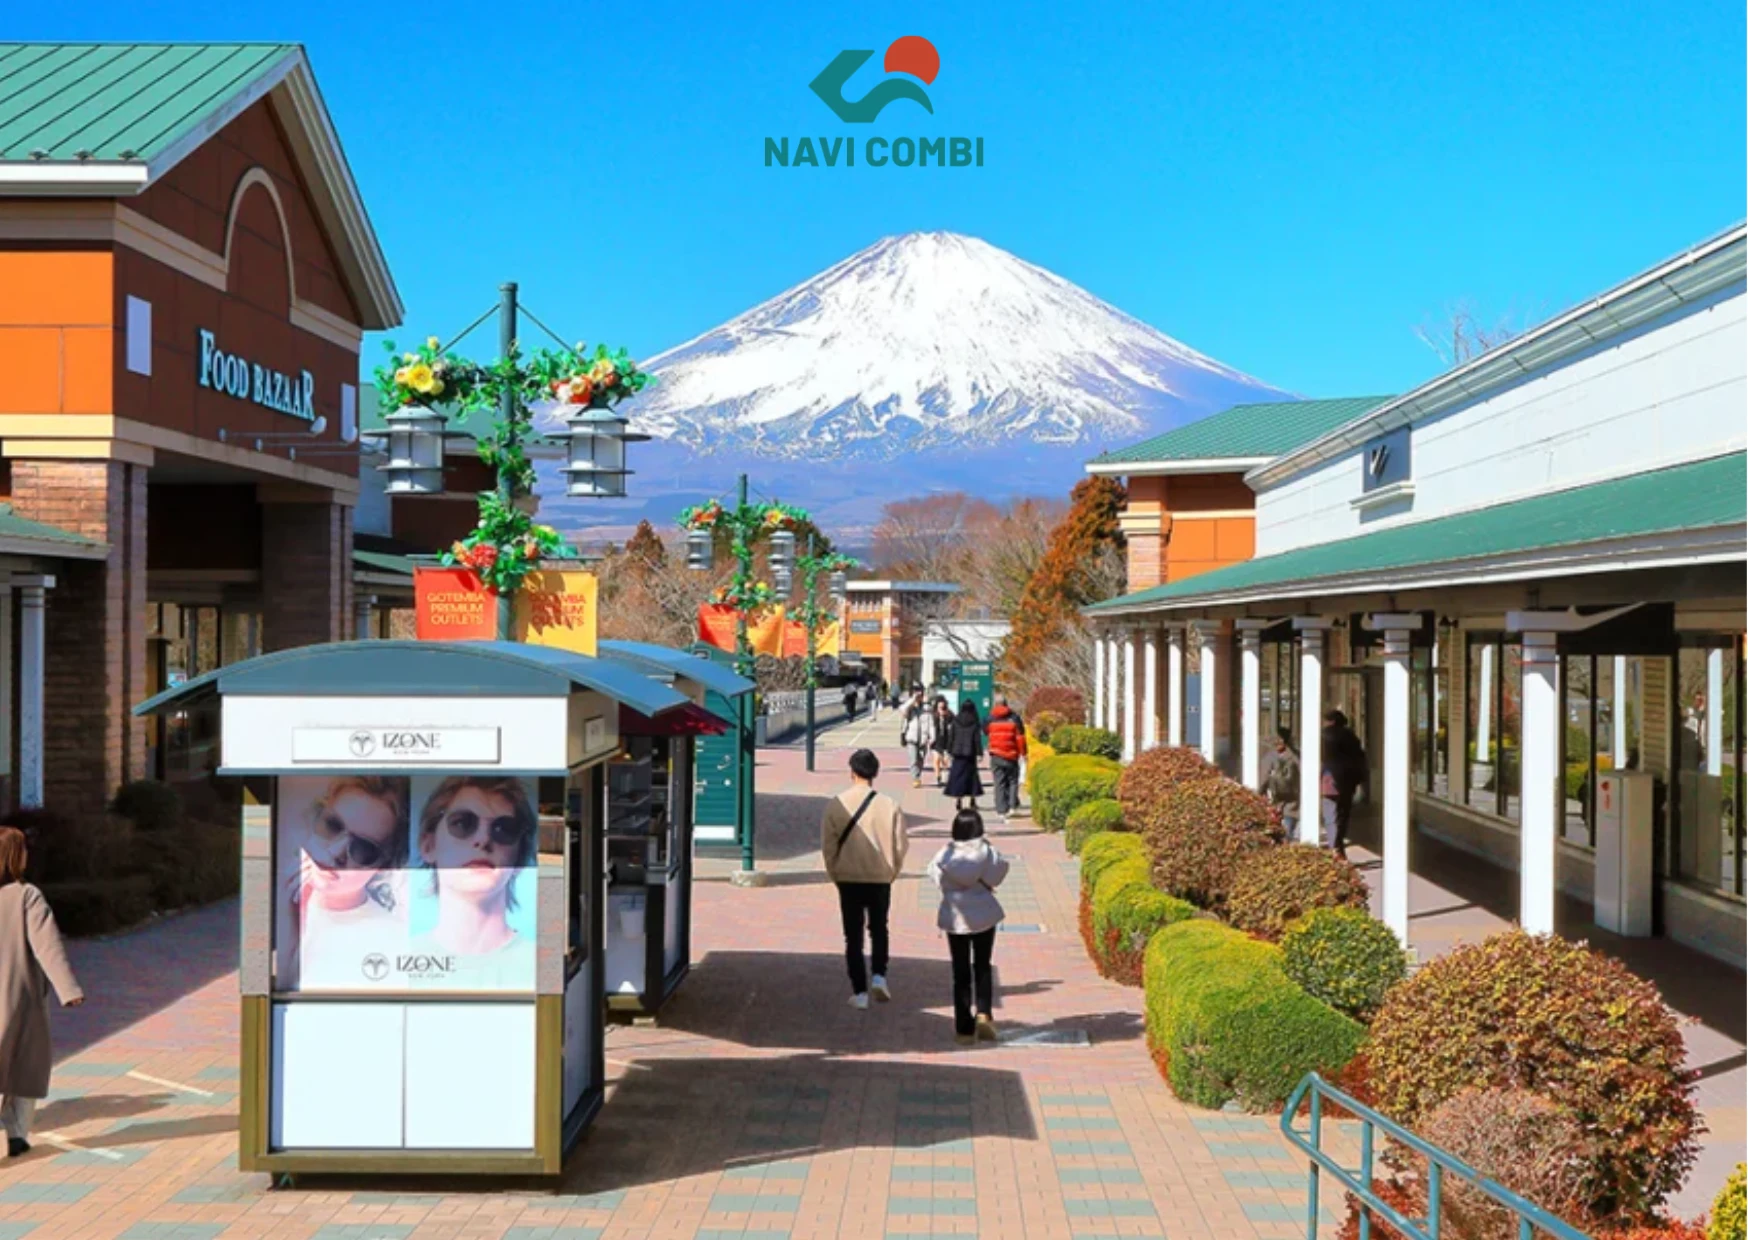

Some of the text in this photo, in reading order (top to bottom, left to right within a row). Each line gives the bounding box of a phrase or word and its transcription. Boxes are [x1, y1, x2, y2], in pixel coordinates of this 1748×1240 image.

[200, 328, 316, 421] FOOD BAZAAR
[427, 592, 486, 603] GOTEMBA
[528, 592, 587, 604] GOMBA
[430, 603, 484, 614] PREMIUM
[430, 614, 484, 626] OUTLETS
[382, 732, 442, 748] IZONE
[396, 955, 456, 972] IZONE
